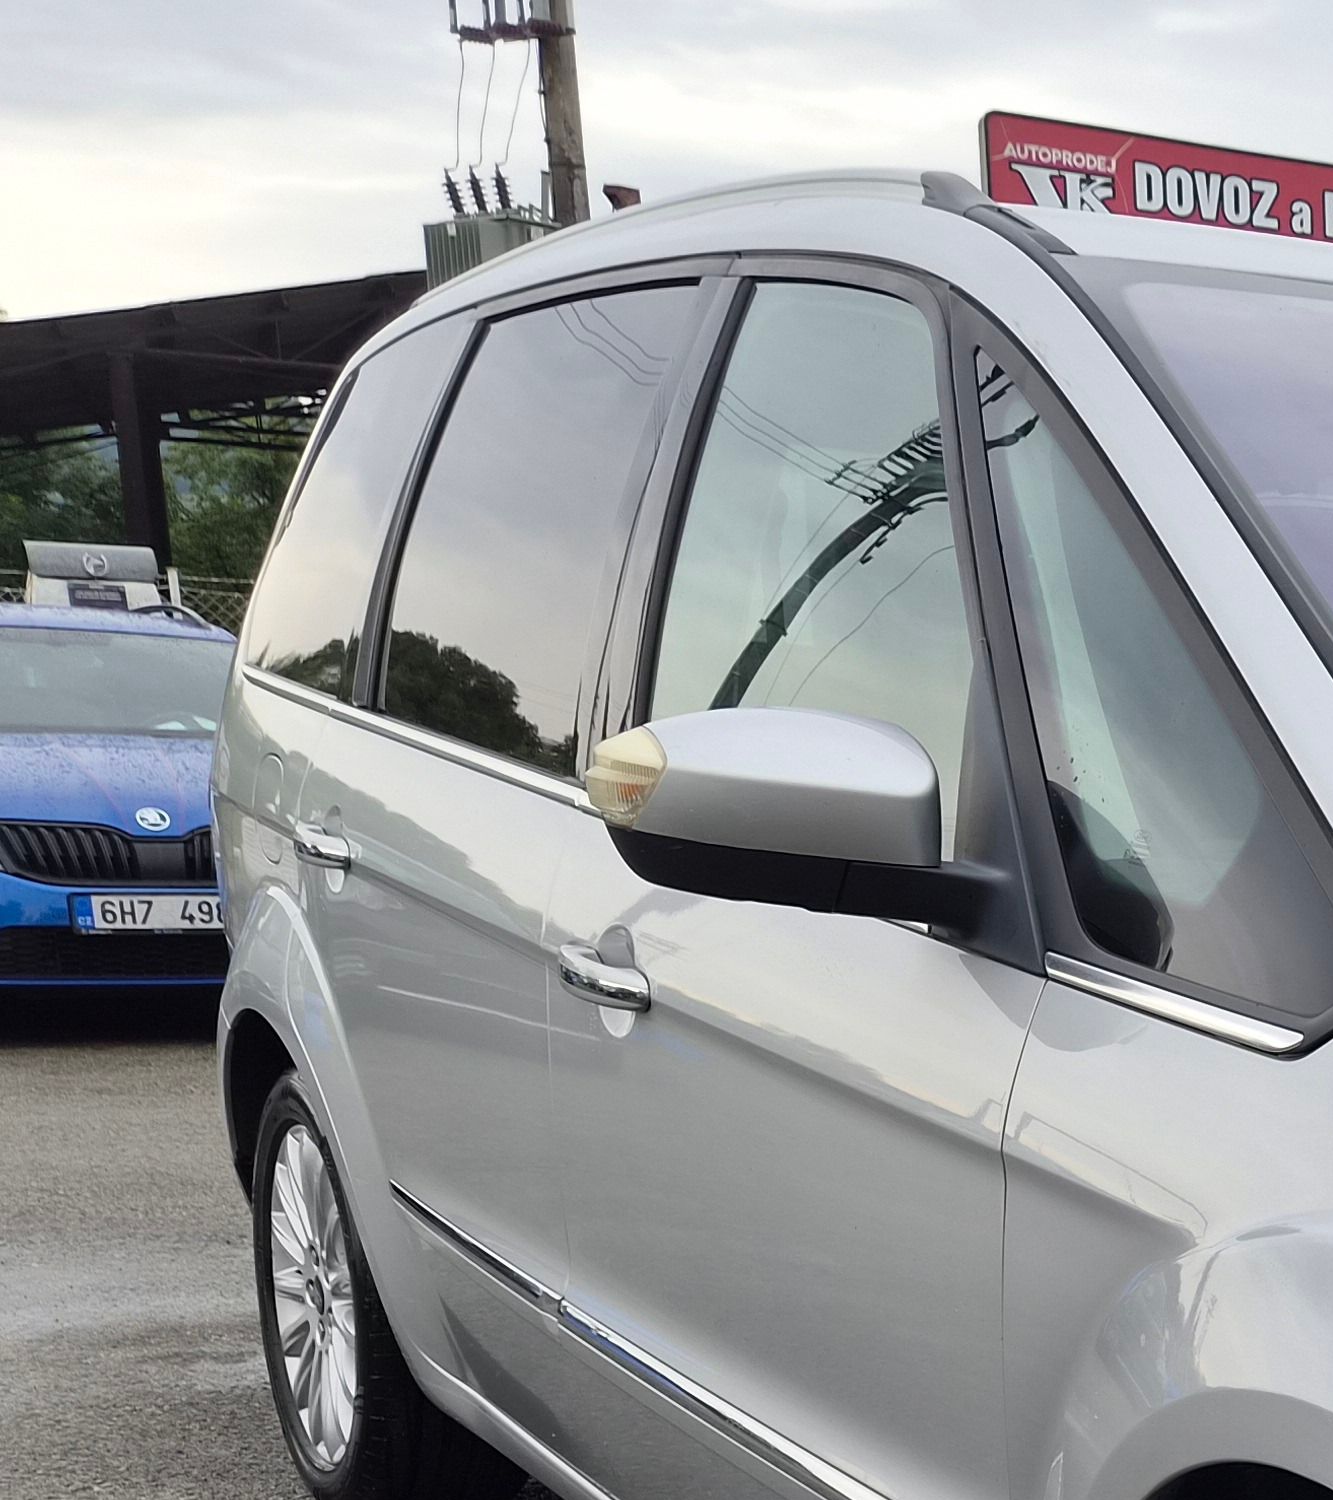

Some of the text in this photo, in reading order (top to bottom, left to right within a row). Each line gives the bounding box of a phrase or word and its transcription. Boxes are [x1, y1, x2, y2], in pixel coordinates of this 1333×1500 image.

[1003, 142, 1117, 173] AUTOPRODEJ
[1134, 160, 1280, 231] DOVOZ
[1290, 198, 1314, 237] a
[78, 915, 93, 926] CZ
[100, 900, 154, 925] 6H7
